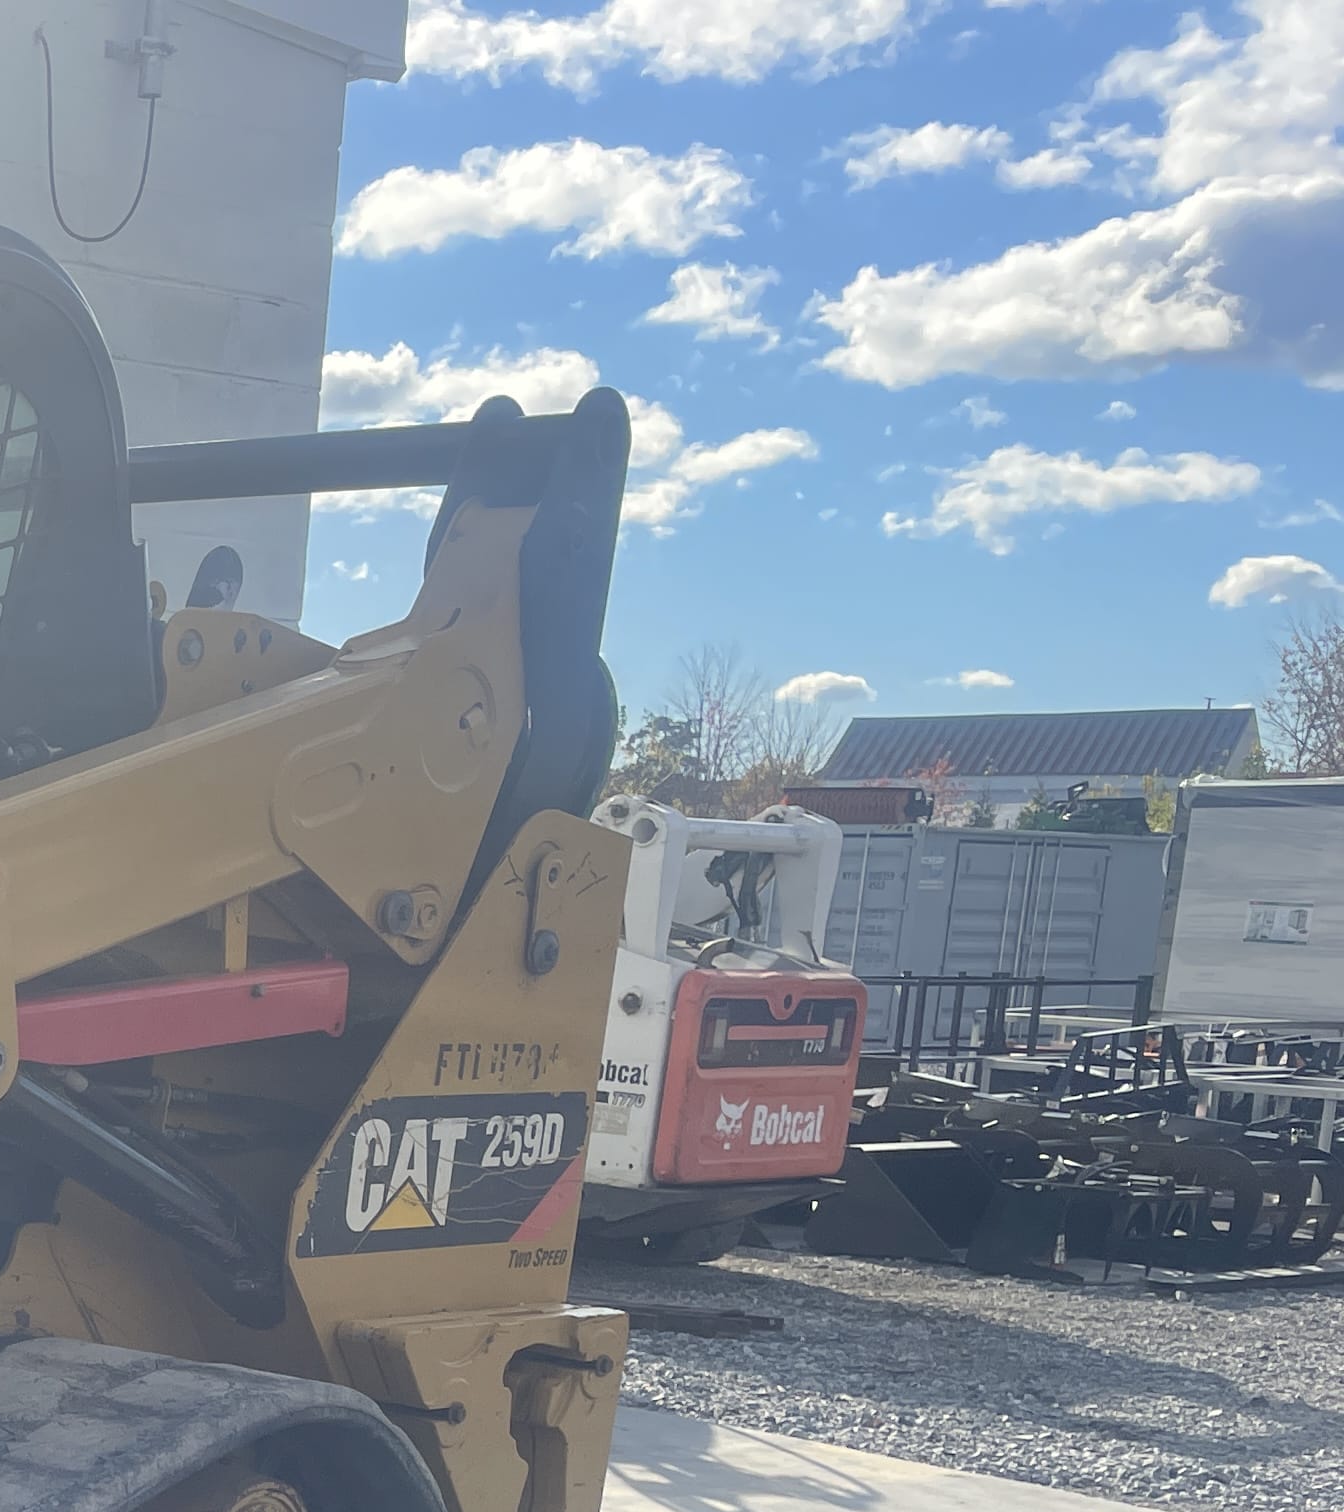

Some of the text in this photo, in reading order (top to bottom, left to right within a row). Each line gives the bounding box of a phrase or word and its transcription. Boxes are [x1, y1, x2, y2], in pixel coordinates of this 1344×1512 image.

[612, 1090, 647, 1108] T770
[749, 1103, 825, 1146] Bobcat
[345, 1113, 565, 1232] CAT 259D
